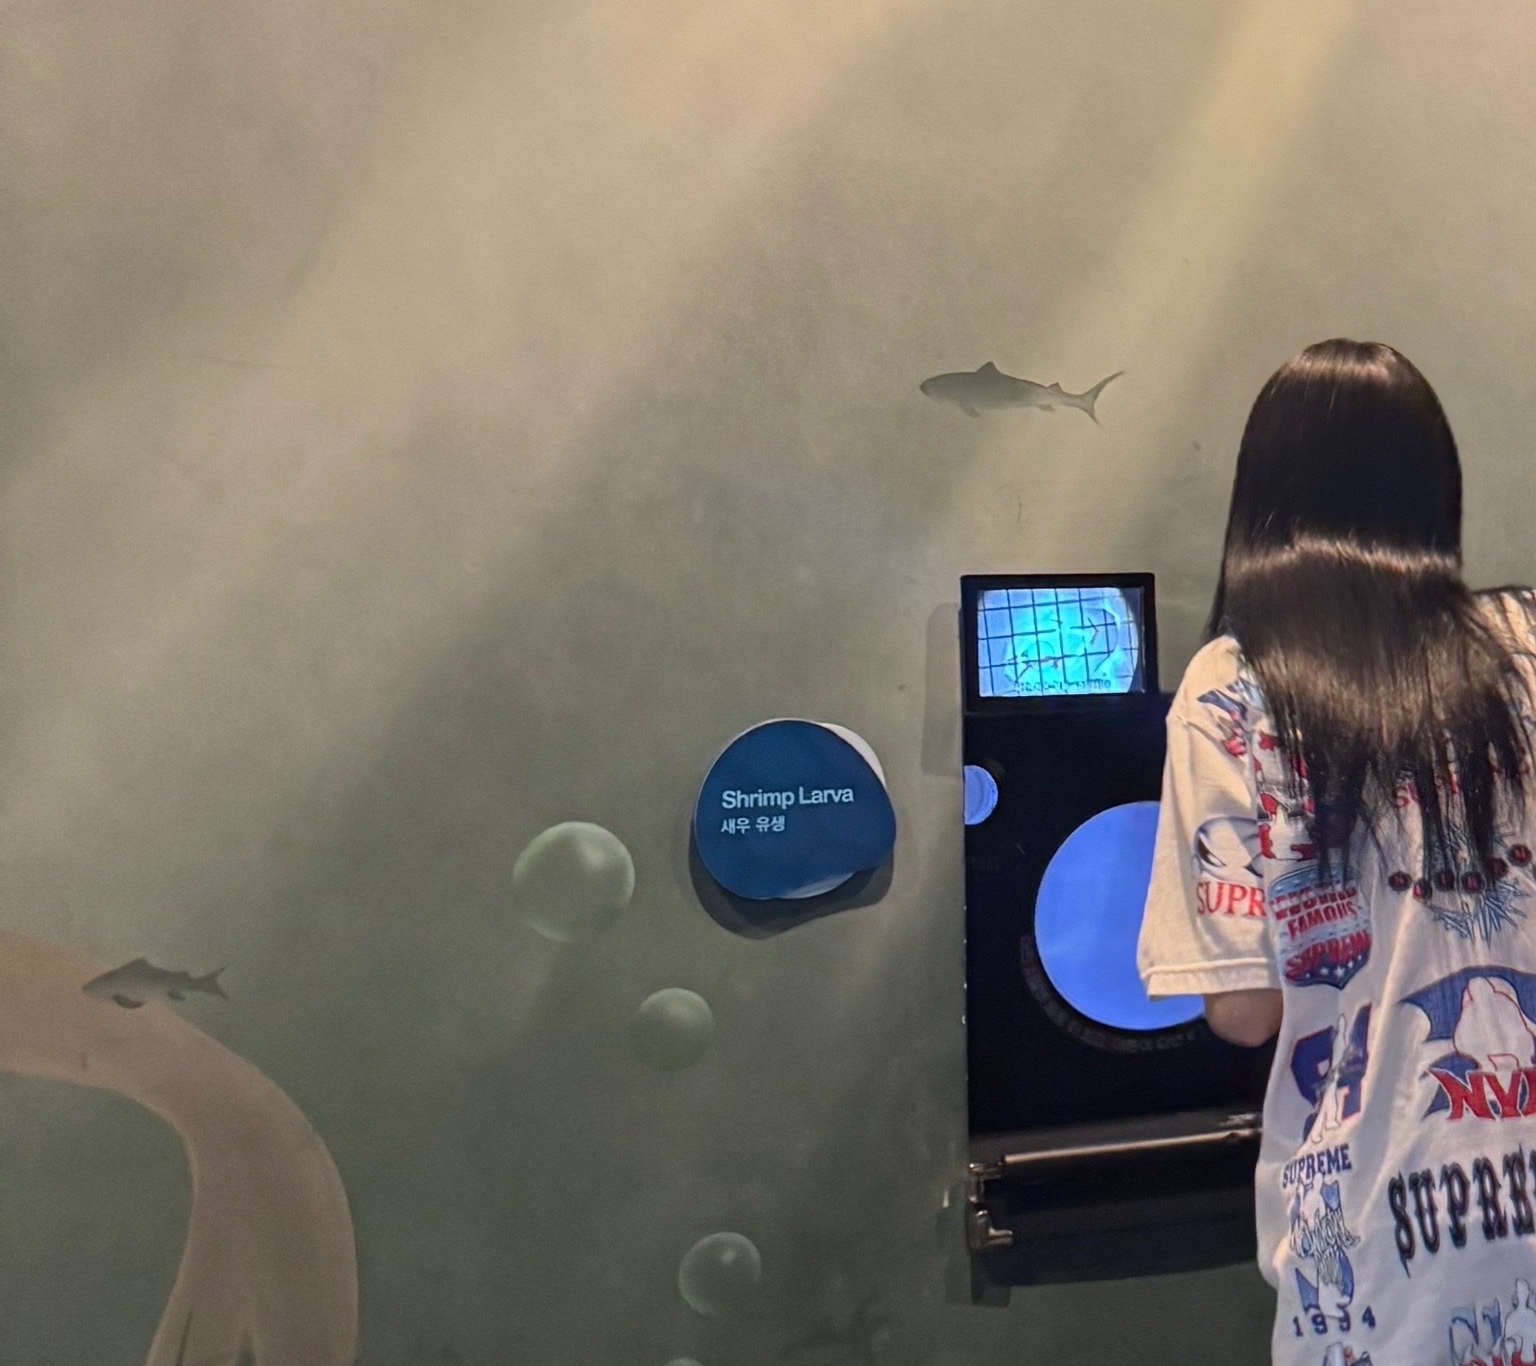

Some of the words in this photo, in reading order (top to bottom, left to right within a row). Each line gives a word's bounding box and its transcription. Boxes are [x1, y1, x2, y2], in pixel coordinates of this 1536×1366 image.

[721, 788, 795, 810] Shrimp
[799, 786, 854, 805] Larva
[720, 817, 751, 835] 새우
[755, 815, 786, 833] 유생
[1282, 1143, 1352, 1189] SUPREME
